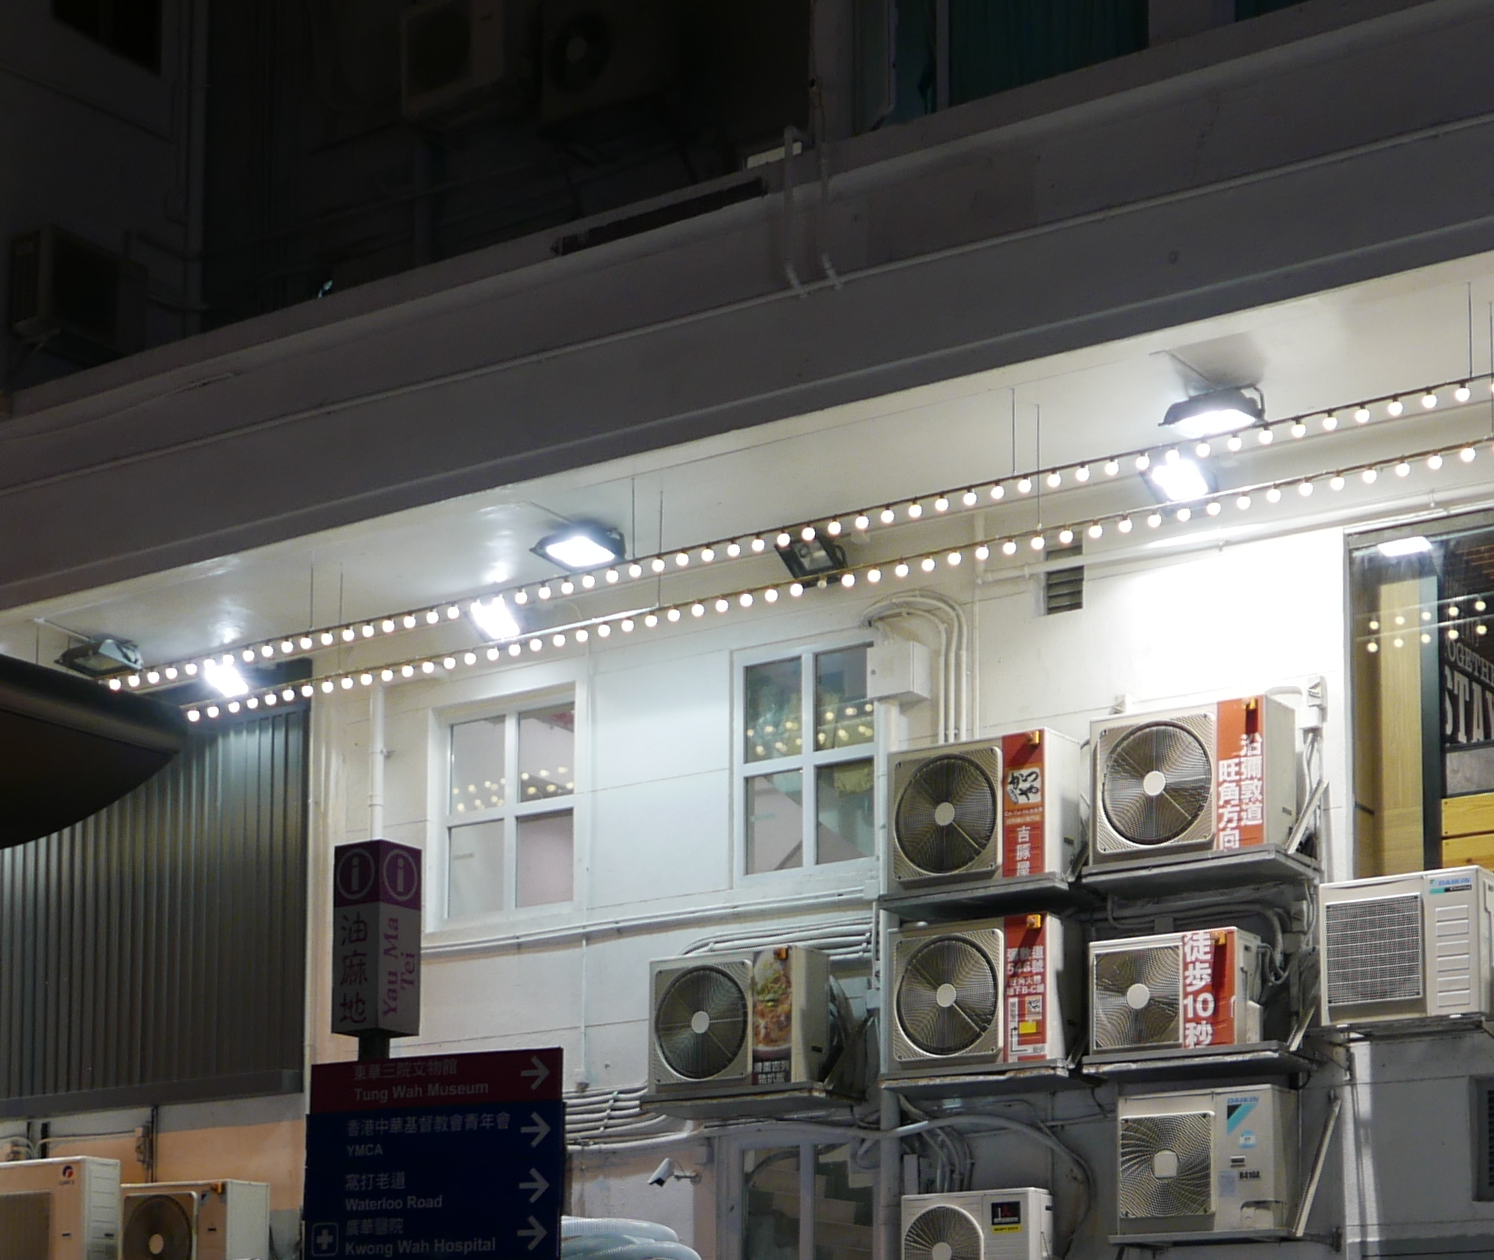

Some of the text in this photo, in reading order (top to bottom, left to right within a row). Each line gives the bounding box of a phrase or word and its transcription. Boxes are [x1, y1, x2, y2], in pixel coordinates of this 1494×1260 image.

[1219, 758, 1240, 851] 旺角方向
[340, 912, 368, 1023] 油麻地
[383, 918, 399, 1016] Yau Ma
[400, 952, 415, 990] Tei
[1183, 931, 1215, 1049] 徒步10秒
[354, 1058, 457, 1081] 東華三院文物館
[354, 1082, 489, 1103] Tung Wah Museum
[346, 1143, 384, 1157] YMCA
[344, 1171, 406, 1191] 窩打老道
[345, 1194, 443, 1211] Waterloo Road
[346, 1217, 404, 1236] 廣華醫院
[345, 1237, 496, 1258] Kwong Wah Hospital
